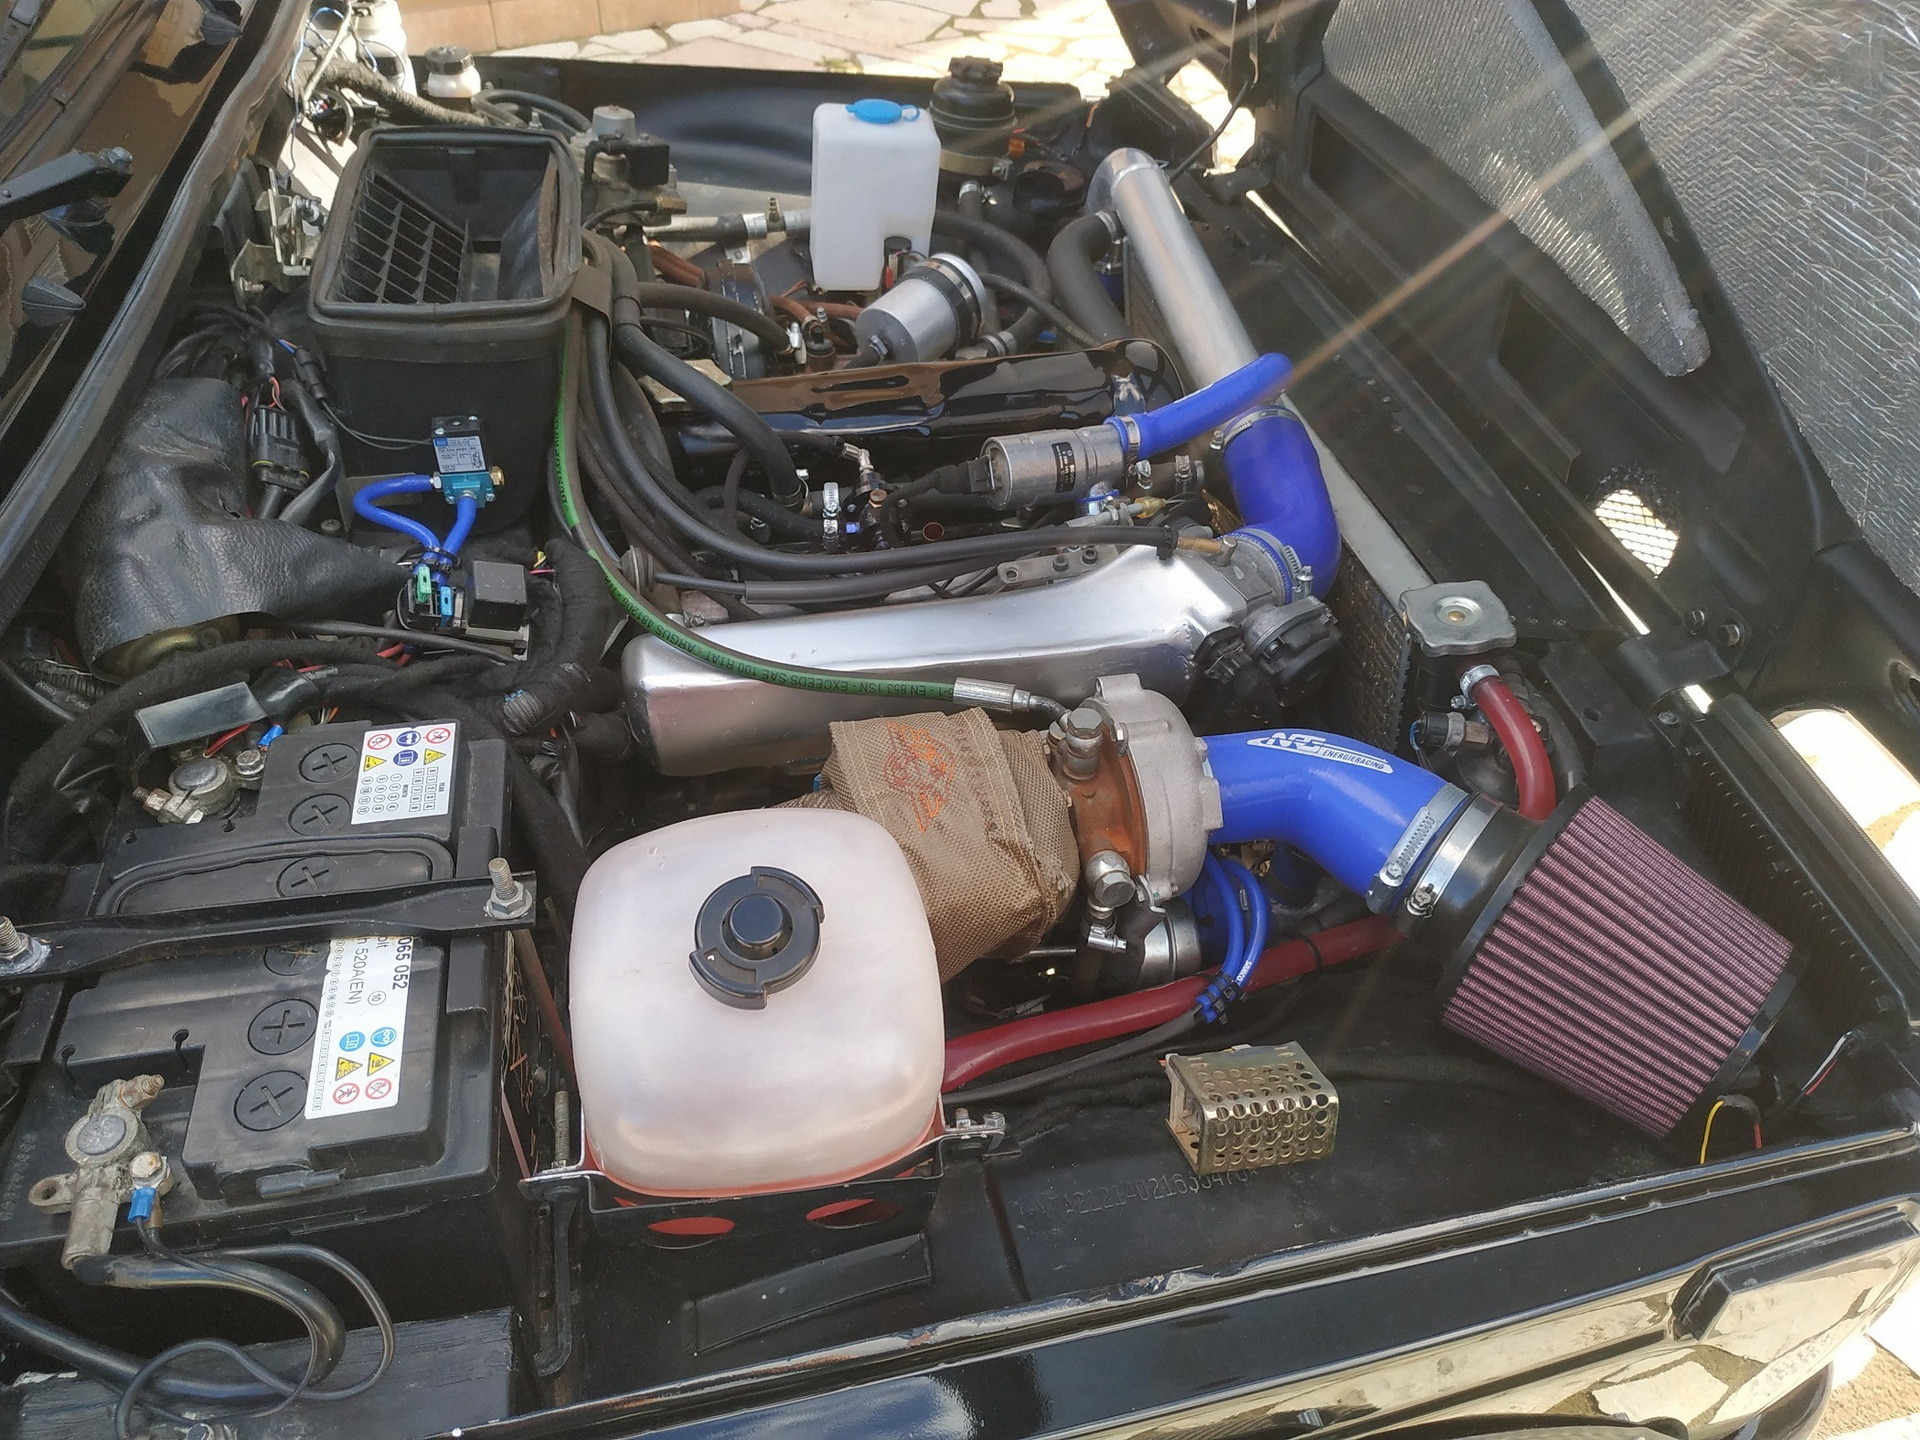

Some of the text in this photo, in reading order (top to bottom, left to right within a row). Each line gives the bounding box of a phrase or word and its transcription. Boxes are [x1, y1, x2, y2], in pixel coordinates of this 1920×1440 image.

[621, 596, 654, 629] 481206
[655, 624, 697, 652] ARGUS
[704, 653, 735, 671] R1AT
[737, 661, 757, 677] 100
[761, 669, 787, 684] SAE
[791, 675, 849, 691] EXCEEDS
[860, 682, 881, 693] 1SN
[887, 684, 907, 694] 853
[910, 685, 926, 695] EN
[1322, 749, 1386, 770] ENERGIERACING
[376, 936, 390, 949] olt
[345, 937, 370, 1005] h 520A(EN)
[392, 936, 413, 990] 065 052
[1236, 960, 1252, 981] SAMCO
